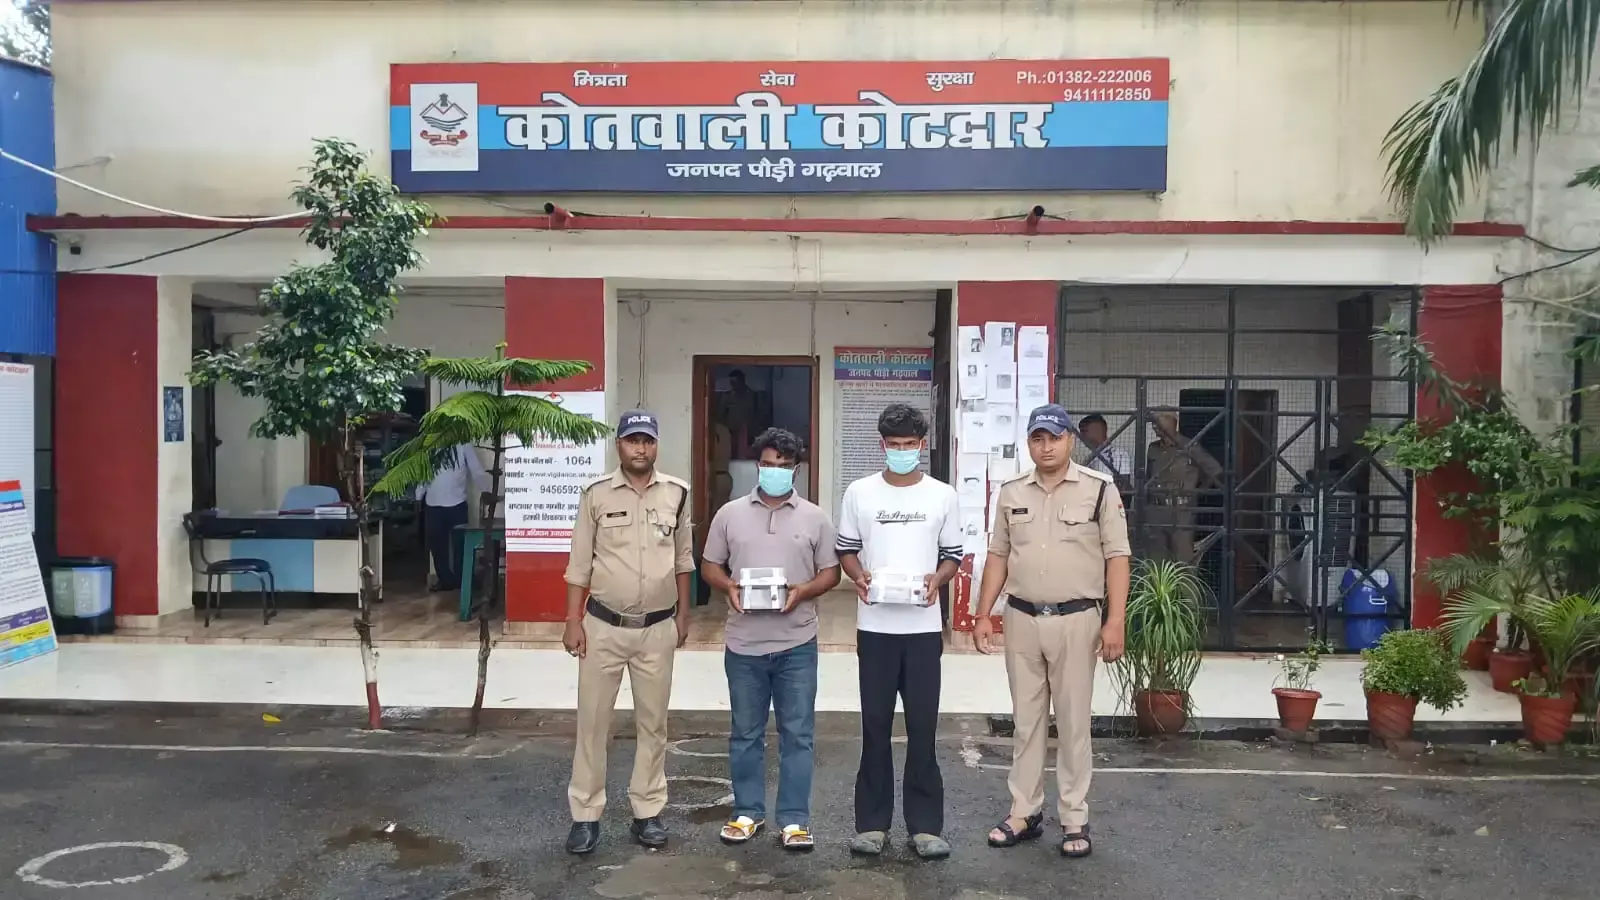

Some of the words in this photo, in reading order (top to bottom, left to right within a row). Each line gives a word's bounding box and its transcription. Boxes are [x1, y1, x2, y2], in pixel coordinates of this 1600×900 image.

[573, 70, 628, 87] मित्रता
[760, 70, 795, 87] सेवा
[926, 71, 975, 91] सुरक्षा
[1016, 70, 1152, 85] Ph.:01382-222006
[1063, 88, 1152, 101] 9411112850
[497, 91, 796, 151] कोतवाली
[813, 90, 1054, 150] कोटद्वार
[666, 163, 742, 178] जनपद
[748, 157, 796, 183] पौड़ी
[801, 162, 883, 183] गढ़वाल
[628, 415, 651, 424] POLICE
[1035, 414, 1059, 423] POLICE
[565, 456, 592, 466] 1064
